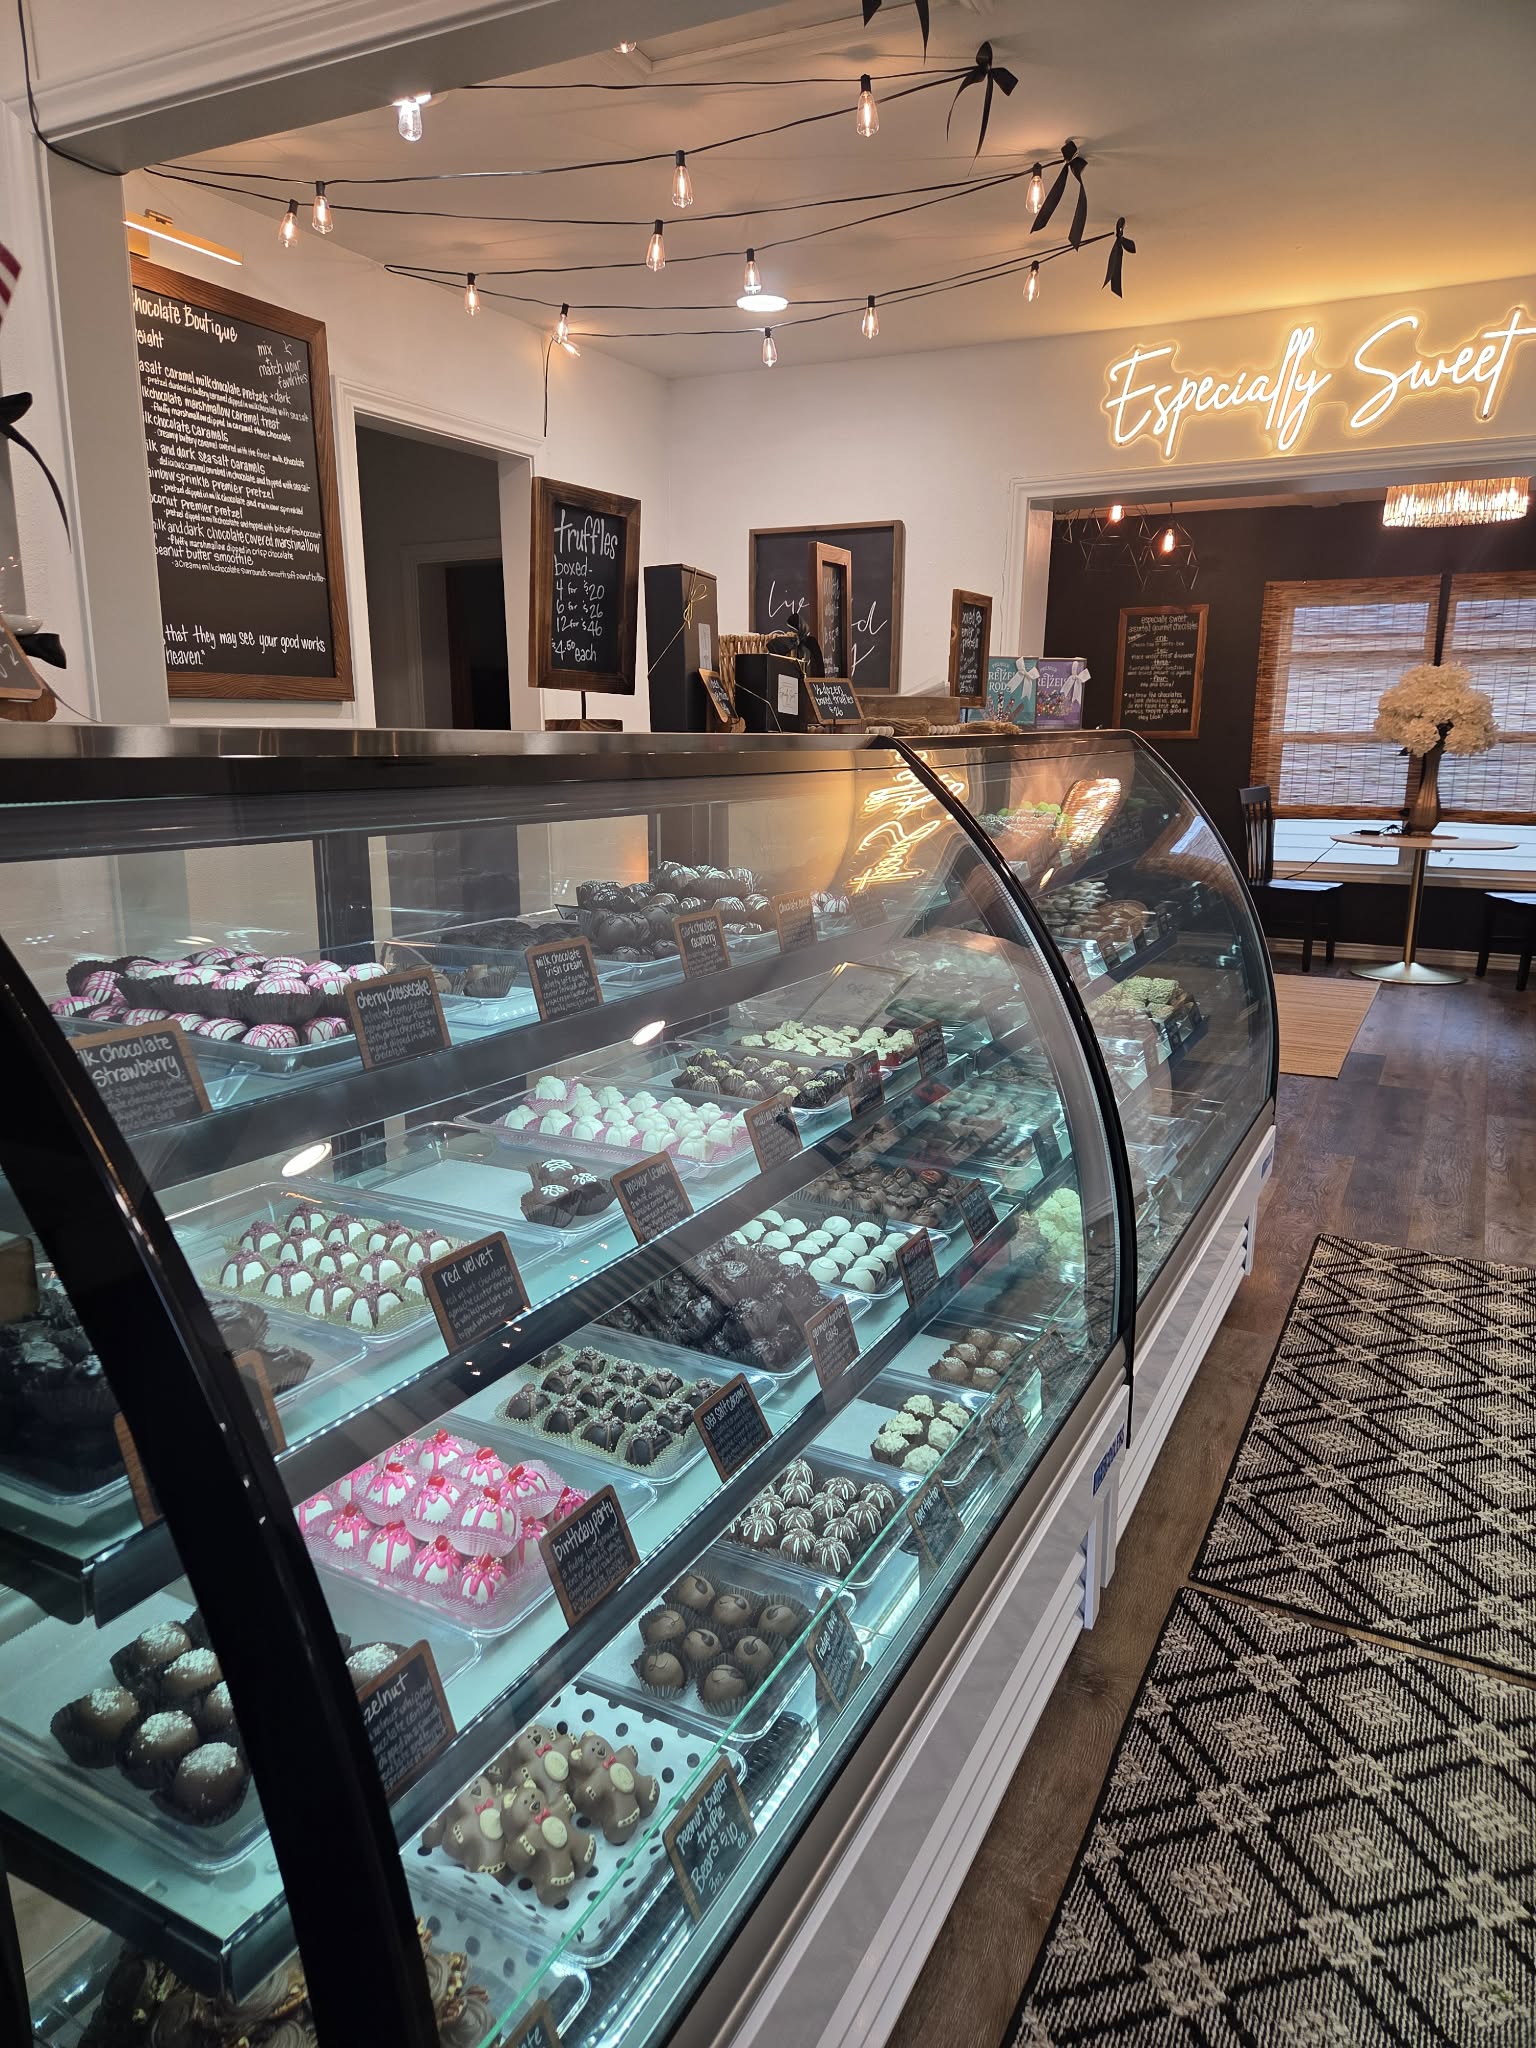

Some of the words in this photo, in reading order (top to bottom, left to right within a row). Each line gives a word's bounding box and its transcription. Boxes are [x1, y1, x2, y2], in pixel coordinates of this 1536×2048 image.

[133, 289, 181, 324] hocolate
[182, 304, 238, 343] Boutique
[135, 328, 164, 348] eight
[257, 340, 273, 356] mix
[138, 360, 162, 375] asalt
[165, 366, 194, 384] caramel
[196, 375, 211, 389] milk
[211, 377, 241, 397] chocolate
[242, 387, 268, 404] pretzels
[274, 389, 291, 404] dark
[258, 360, 284, 377] match
[284, 359, 301, 376] your
[278, 372, 309, 389] favorites
[1107, 326, 1332, 458] Especially
[1350, 310, 1536, 429] Sweet
[149, 386, 182, 406] chocolate
[185, 397, 230, 418] marshmallow
[231, 408, 259, 426] caramel
[260, 415, 280, 430] treat
[143, 411, 153, 426] lk
[153, 414, 191, 434] chocolate
[191, 425, 229, 442] caramels
[266, 430, 291, 442] chocolate
[160, 444, 175, 456] and
[176, 445, 196, 460] dark
[231, 458, 265, 475] caramels
[147, 466, 175, 481] ainbow
[176, 472, 209, 488] sprinkle
[211, 480, 243, 495] premier
[245, 486, 275, 500] pretzel
[150, 494, 178, 507] oconut
[214, 505, 243, 518] pretzel
[167, 520, 183, 534] and
[183, 521, 205, 537] dark
[206, 526, 245, 543] chocolate
[245, 531, 273, 547] covered
[274, 538, 320, 554] marshmallow
[553, 508, 618, 560] truffles
[185, 547, 212, 560] butter
[213, 552, 254, 566] smoothie
[556, 578, 563, 600] 4
[568, 581, 578, 594] for
[556, 599, 565, 614] 6
[568, 601, 578, 611] for
[165, 624, 188, 643] that
[192, 624, 216, 649] they
[219, 631, 237, 648] may
[238, 630, 256, 645] see
[259, 633, 278, 653] your
[280, 634, 300, 653] good
[300, 636, 326, 653] works
[556, 615, 571, 633] 12
[569, 618, 579, 628] for
[574, 643, 597, 663] each
[989, 667, 1016, 682] RETZE
[535, 954, 551, 968] milk
[551, 948, 581, 965] chocolate
[545, 965, 562, 977] irish
[563, 960, 584, 972] cream
[357, 991, 389, 1015] cherry
[386, 979, 432, 1002] cheesecake
[77, 1049, 100, 1067] lk
[441, 1264, 461, 1288] red
[462, 1245, 495, 1275] velvet
[478, 1264, 508, 1288] chocolate
[825, 1324, 839, 1342] cake
[552, 1520, 599, 1563] birthday
[591, 1500, 618, 1535] party
[364, 1672, 409, 1727] zelnut
[369, 1706, 399, 1742] zelnut
[398, 1677, 433, 1716] whipped
[405, 1695, 433, 1726] center
[676, 1803, 706, 1857] peanut
[703, 1772, 729, 1812] butter
[696, 1804, 726, 1849] truffle
[690, 1837, 720, 1896] Bears
